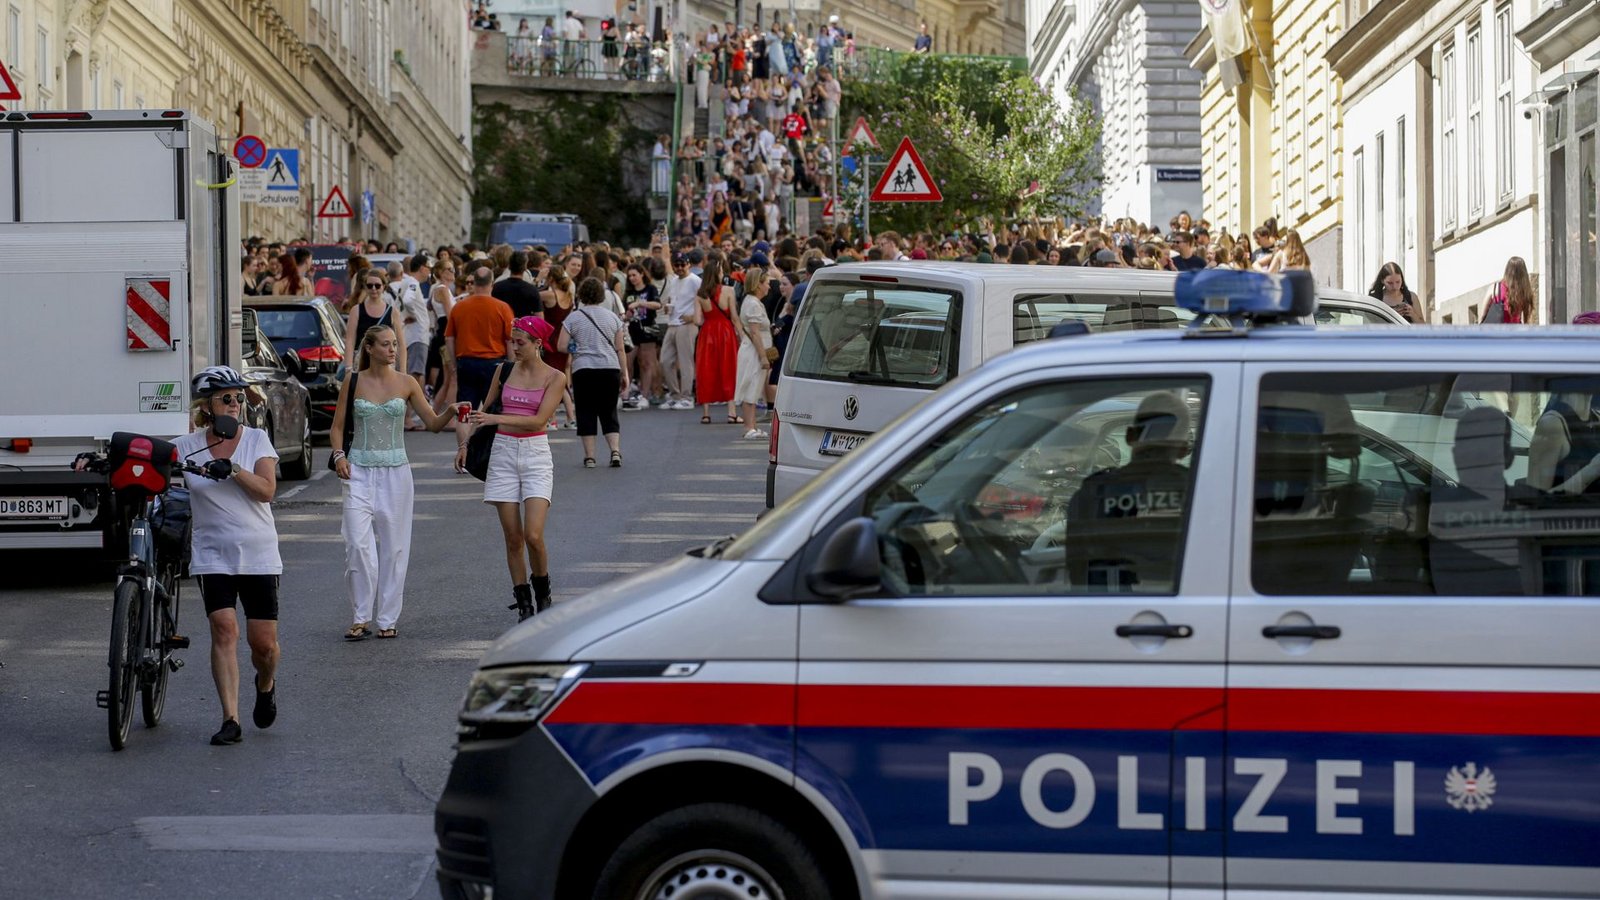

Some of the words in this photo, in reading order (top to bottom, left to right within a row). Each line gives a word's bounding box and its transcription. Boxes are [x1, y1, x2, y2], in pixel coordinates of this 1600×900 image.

[830, 434, 840, 448] W
[18, 500, 43, 514] 863
[46, 500, 63, 513] MT
[1104, 492, 1182, 514] POLIZE
[948, 751, 1415, 836] POLIZEI
